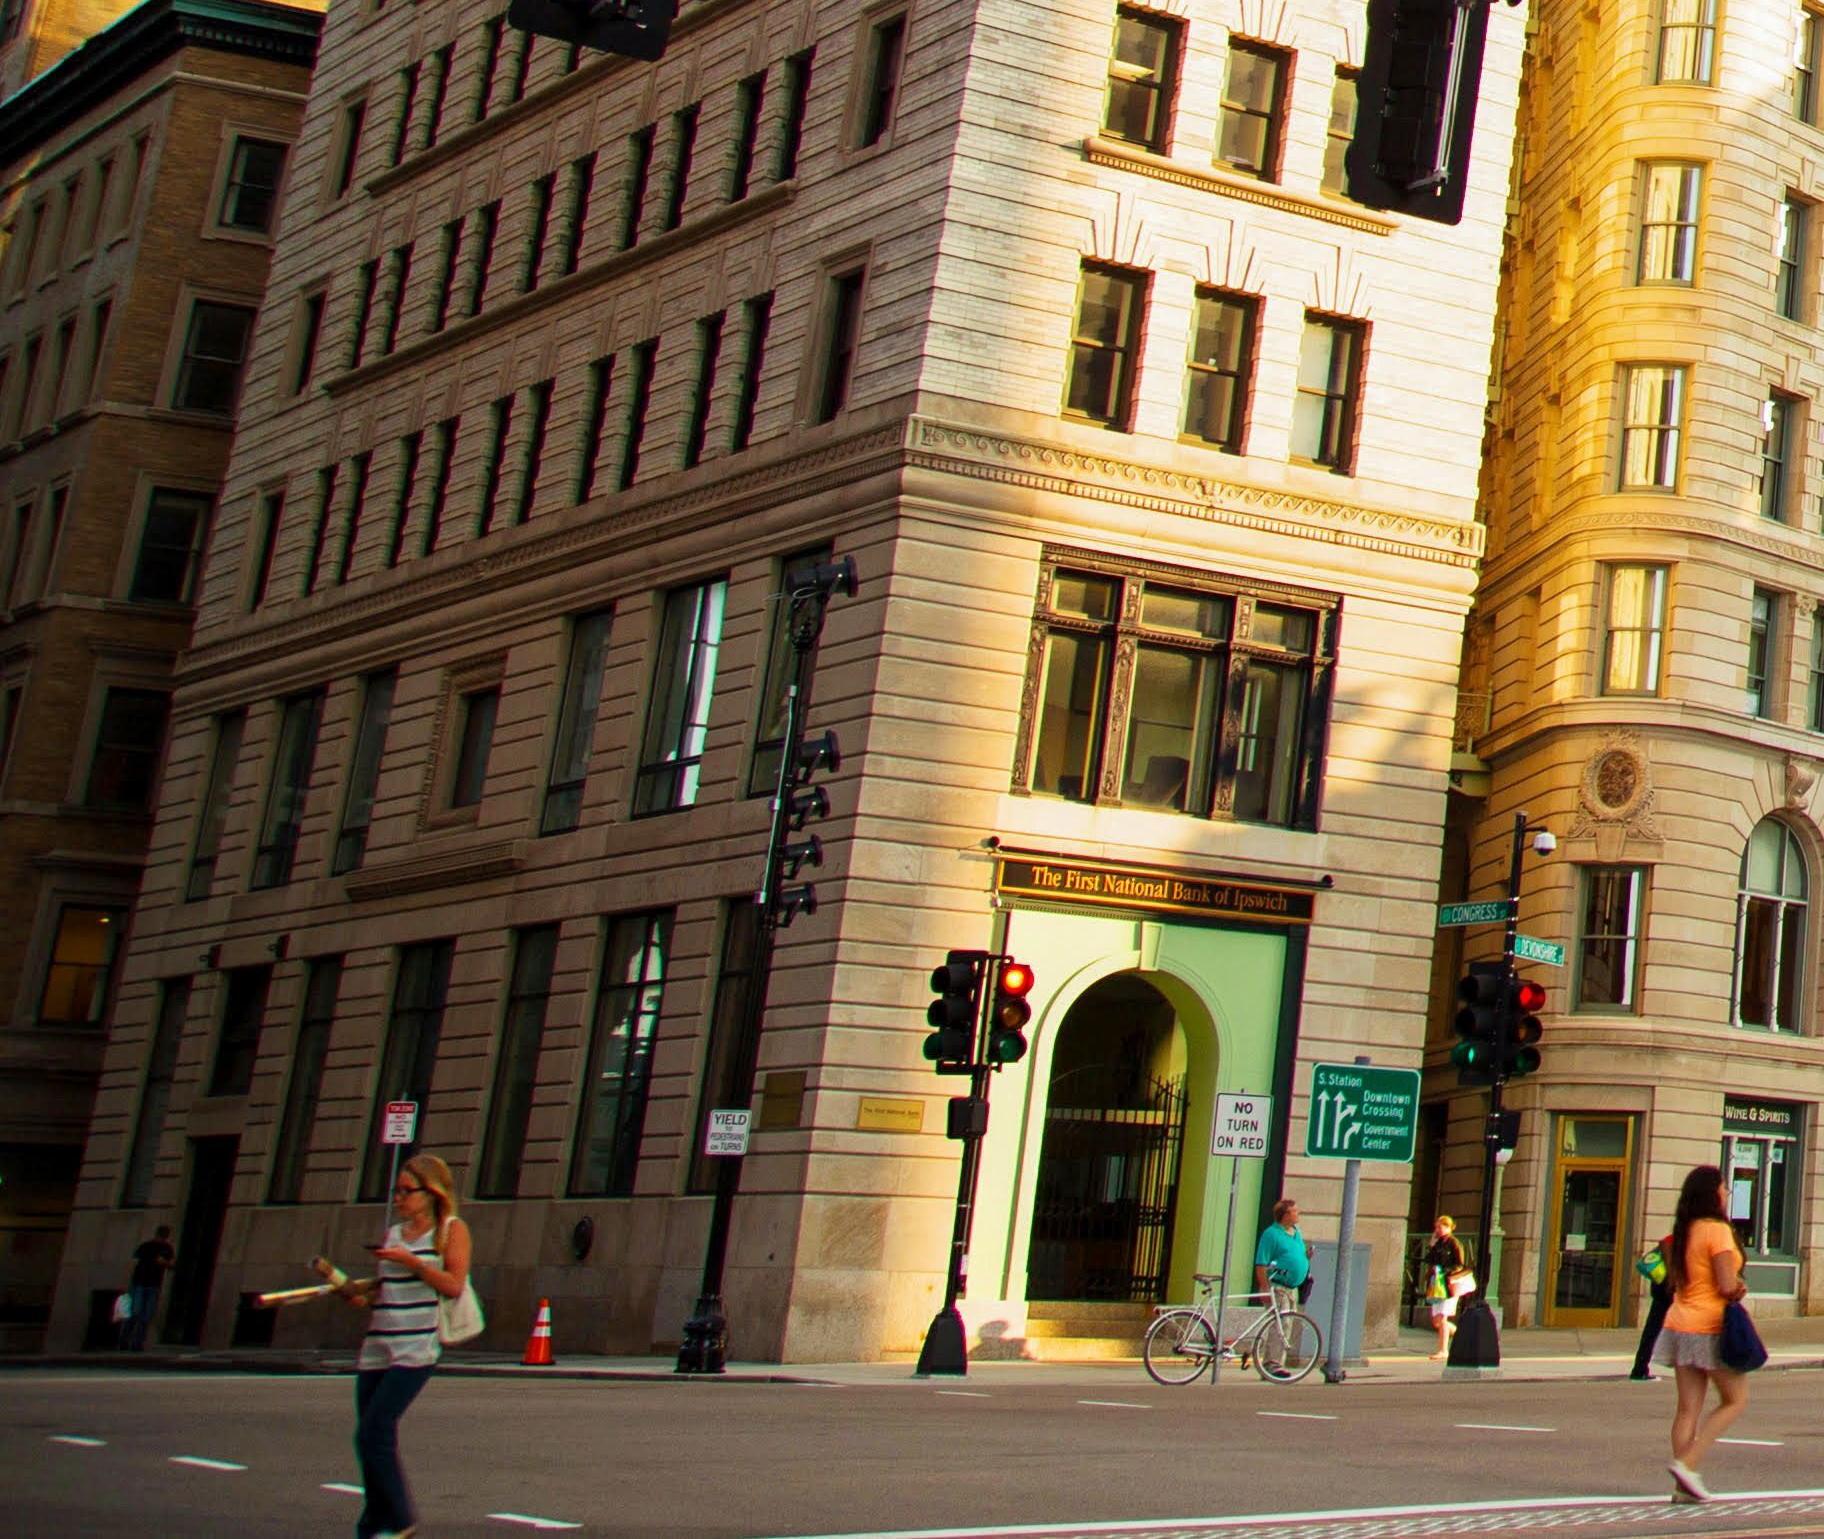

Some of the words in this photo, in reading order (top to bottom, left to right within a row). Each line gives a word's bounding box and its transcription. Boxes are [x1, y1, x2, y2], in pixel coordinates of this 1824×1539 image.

[1031, 865, 1061, 887] The
[1064, 870, 1100, 891] First
[1103, 874, 1169, 899] National
[1173, 883, 1210, 902] Bank
[1215, 886, 1232, 905] of
[1233, 888, 1288, 911] Ipswich
[1451, 904, 1498, 923] CONGRESS
[1520, 939, 1558, 963] DEVONSHIRE
[1319, 1073, 1326, 1085] S.
[1329, 1073, 1362, 1087] Station
[1363, 1090, 1410, 1104] Downtown
[1234, 1101, 1253, 1114] NO
[1362, 1104, 1403, 1120] Crossing
[715, 1113, 747, 1125] YIELD
[1228, 1118, 1258, 1132] TURN
[1363, 1122, 1408, 1137] Government
[1217, 1136, 1233, 1148] ON
[1240, 1137, 1264, 1150] RED
[1362, 1137, 1391, 1149] Center
